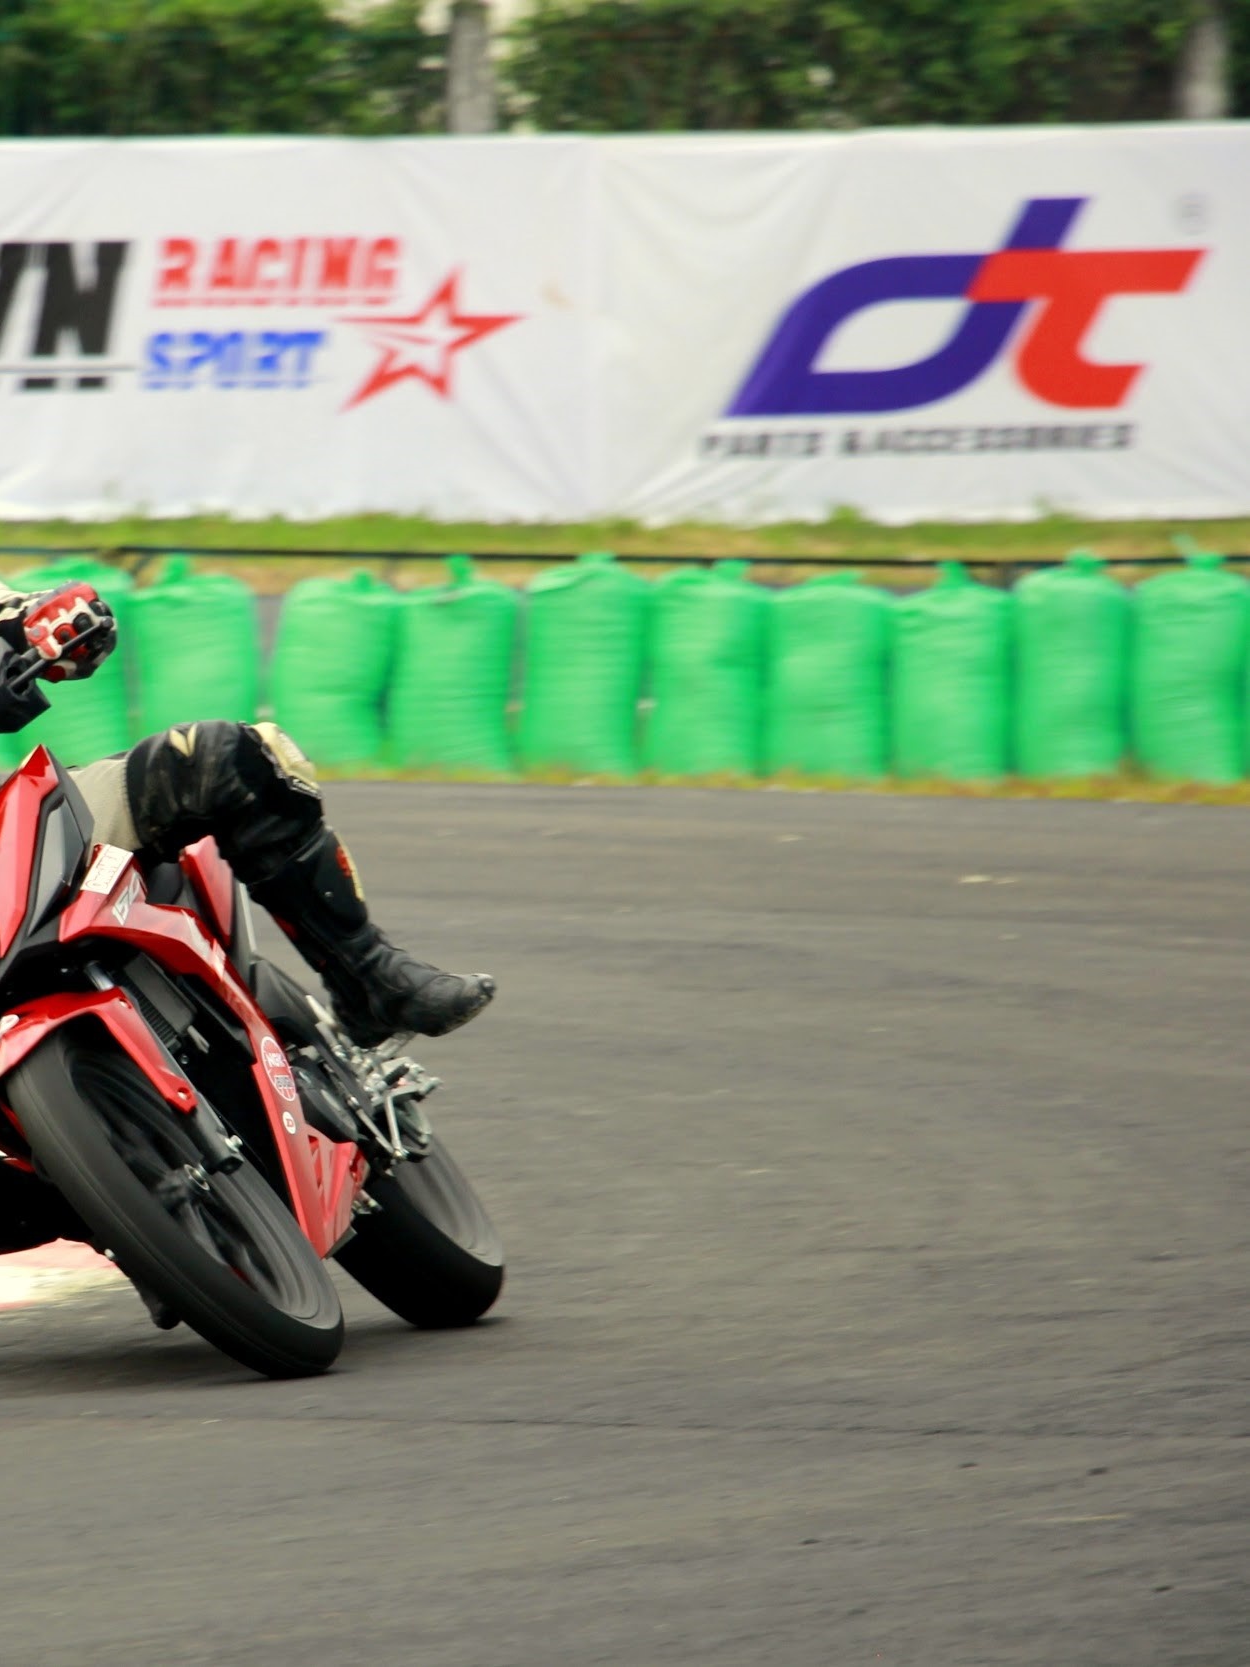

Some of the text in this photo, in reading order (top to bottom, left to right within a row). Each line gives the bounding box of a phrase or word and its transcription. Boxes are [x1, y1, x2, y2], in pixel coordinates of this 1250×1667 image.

[154, 236, 400, 307] RACING
[142, 330, 327, 390] SPORT
[698, 432, 821, 459] PARTS
